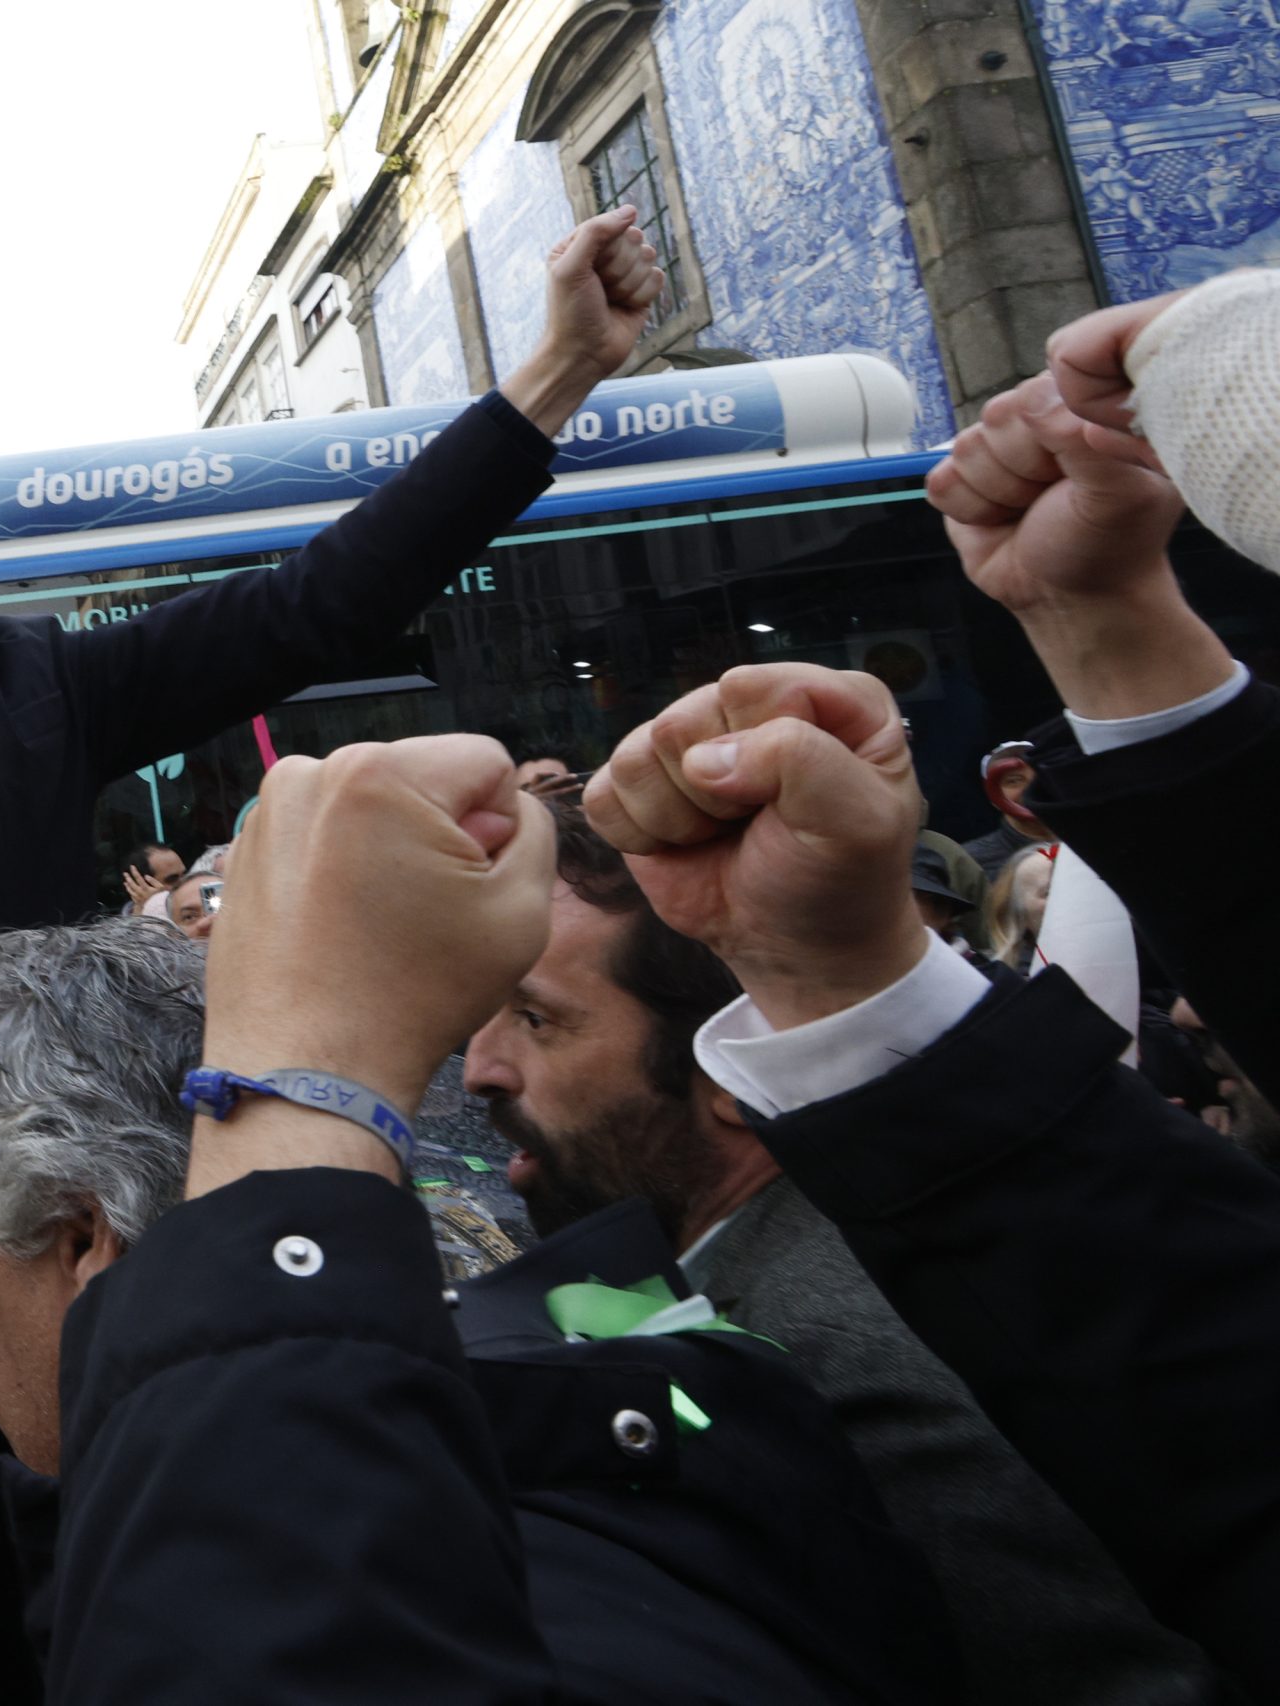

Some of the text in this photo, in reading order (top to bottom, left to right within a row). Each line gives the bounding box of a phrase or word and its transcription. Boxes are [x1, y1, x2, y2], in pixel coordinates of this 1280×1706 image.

[325, 441, 352, 472] a
[616, 389, 736, 436] norte
[17, 446, 234, 508] dourogás
[54, 603, 150, 632] MOB
